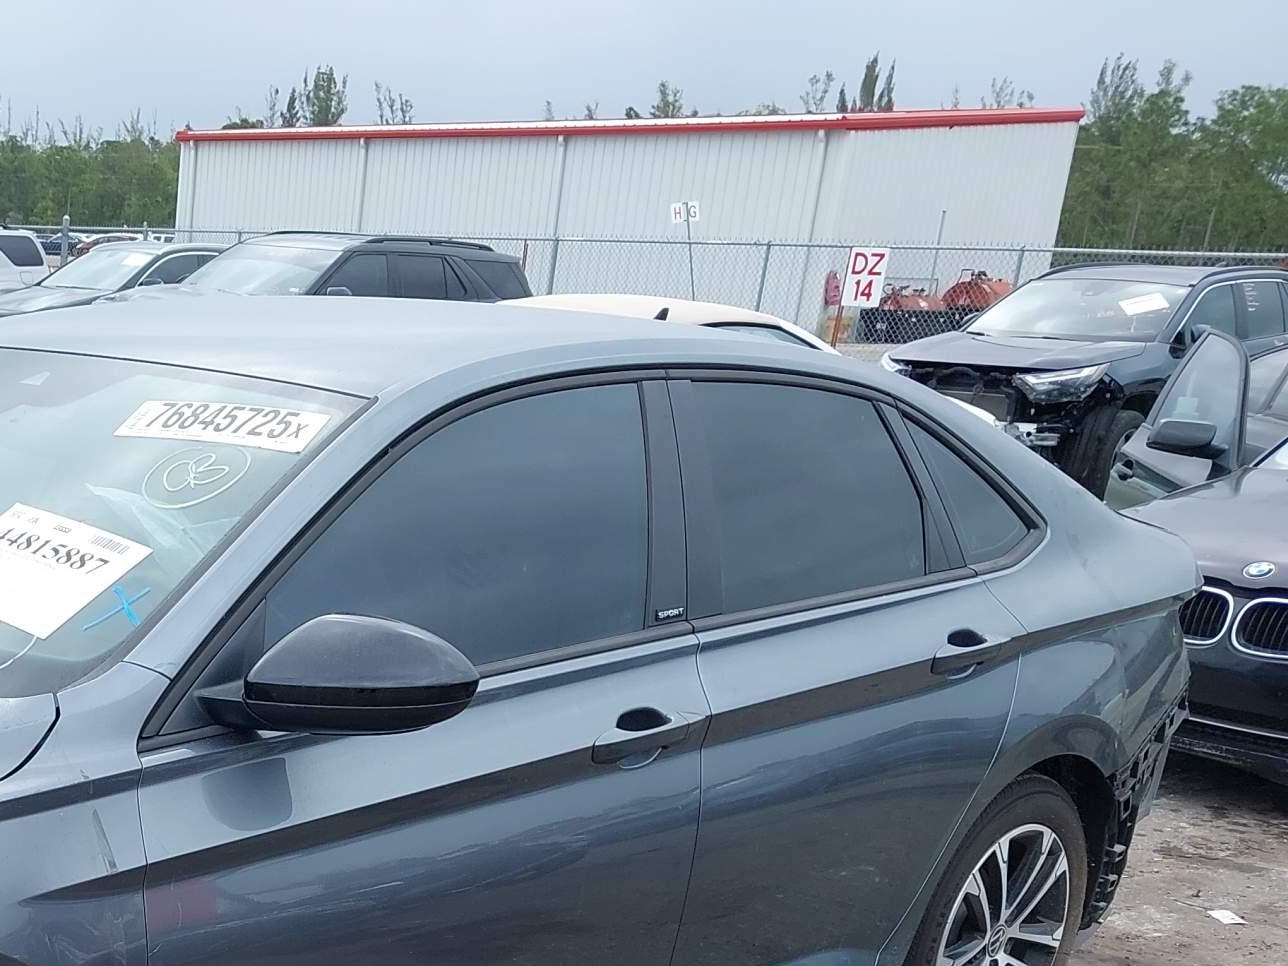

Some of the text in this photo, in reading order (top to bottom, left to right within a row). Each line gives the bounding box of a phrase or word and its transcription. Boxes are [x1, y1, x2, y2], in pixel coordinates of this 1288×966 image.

[688, 205, 697, 218] G
[851, 252, 885, 276] DZ
[854, 279, 873, 301] 14
[658, 607, 684, 619] SPORT
